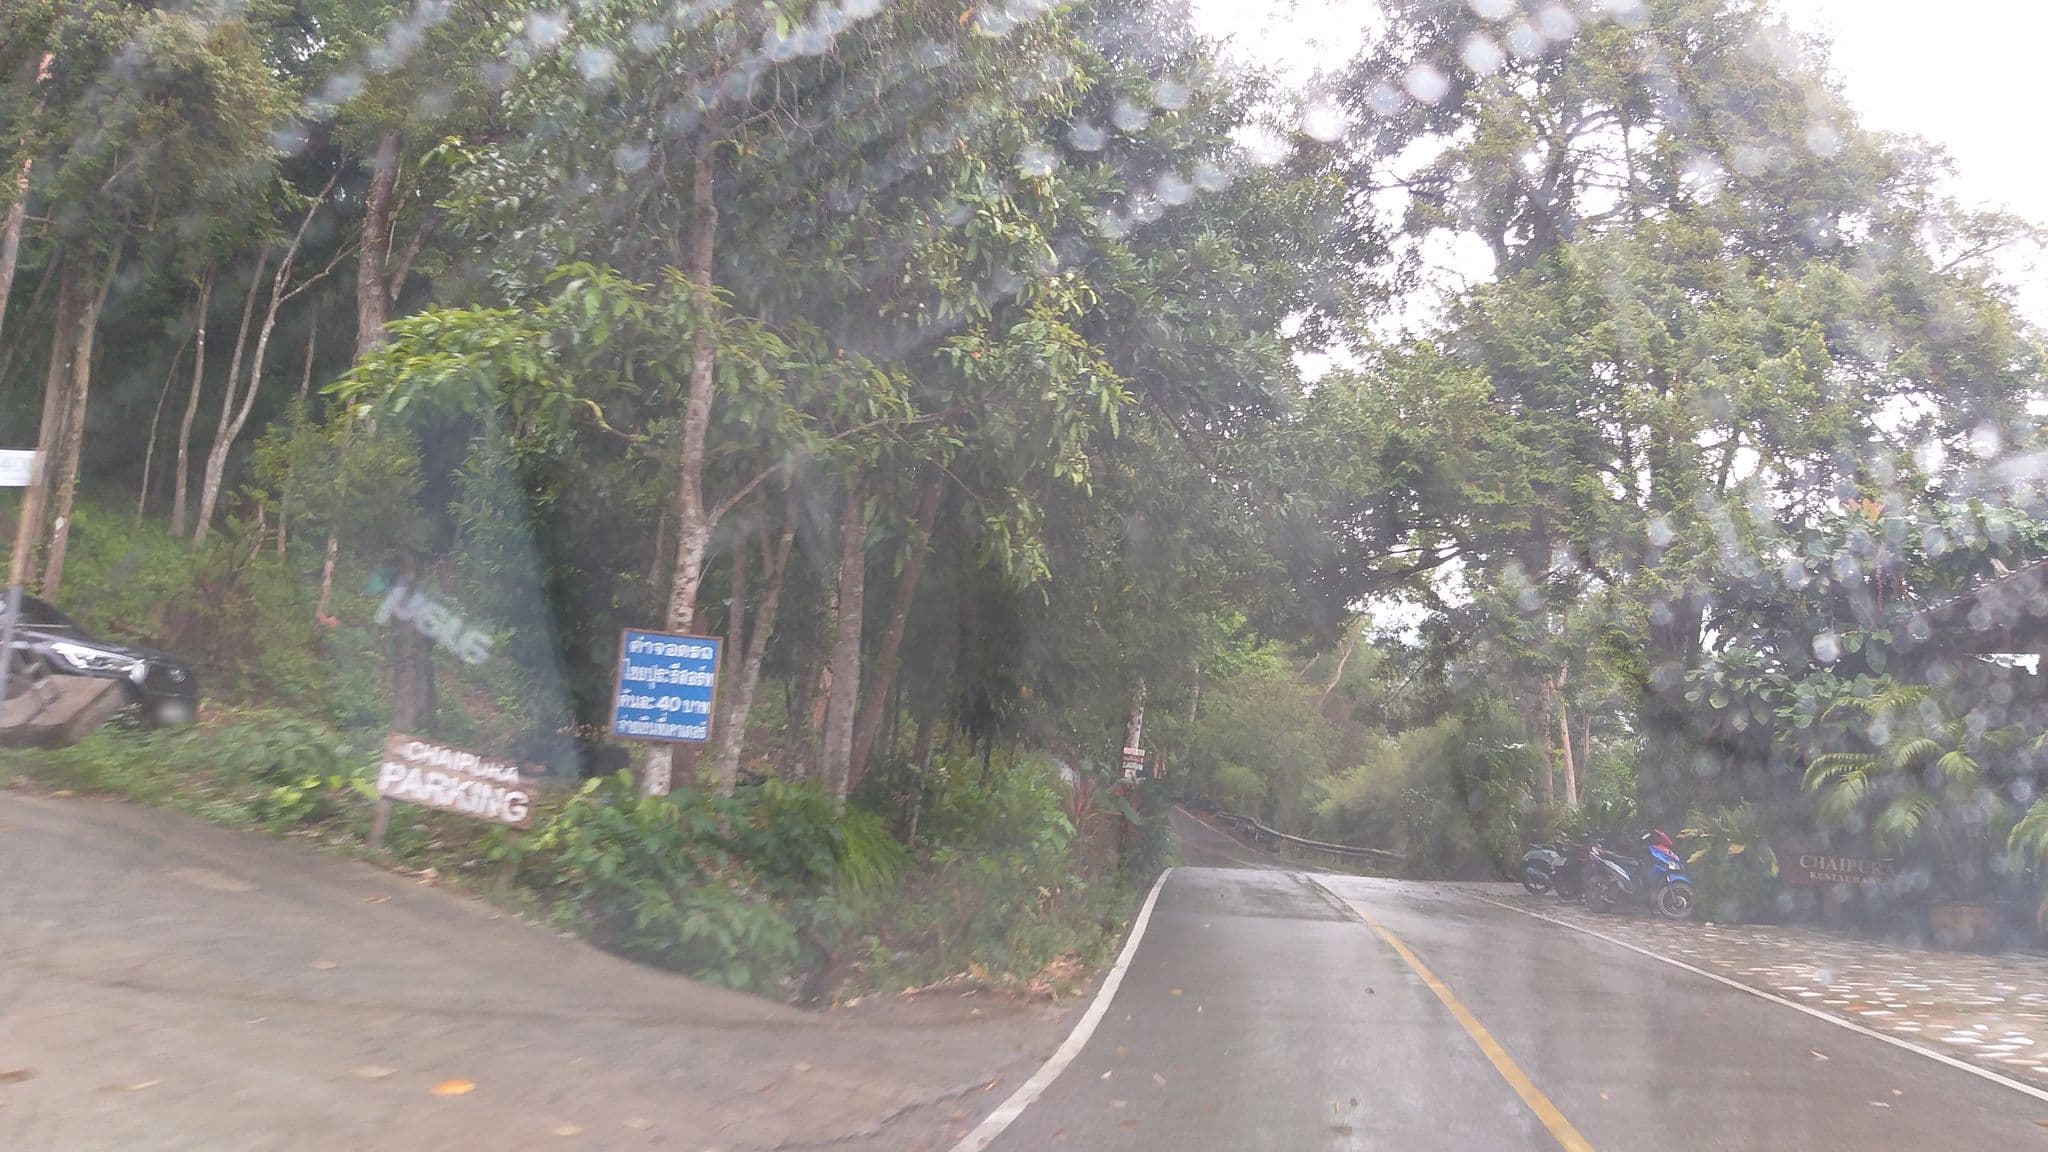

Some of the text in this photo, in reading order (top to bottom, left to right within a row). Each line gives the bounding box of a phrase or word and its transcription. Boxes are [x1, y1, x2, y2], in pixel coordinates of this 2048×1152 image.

[628, 636, 714, 660] ค่าจอดรถ
[656, 696, 681, 712] 40
[682, 700, 711, 714] บาท
[377, 762, 529, 822] PARKING
